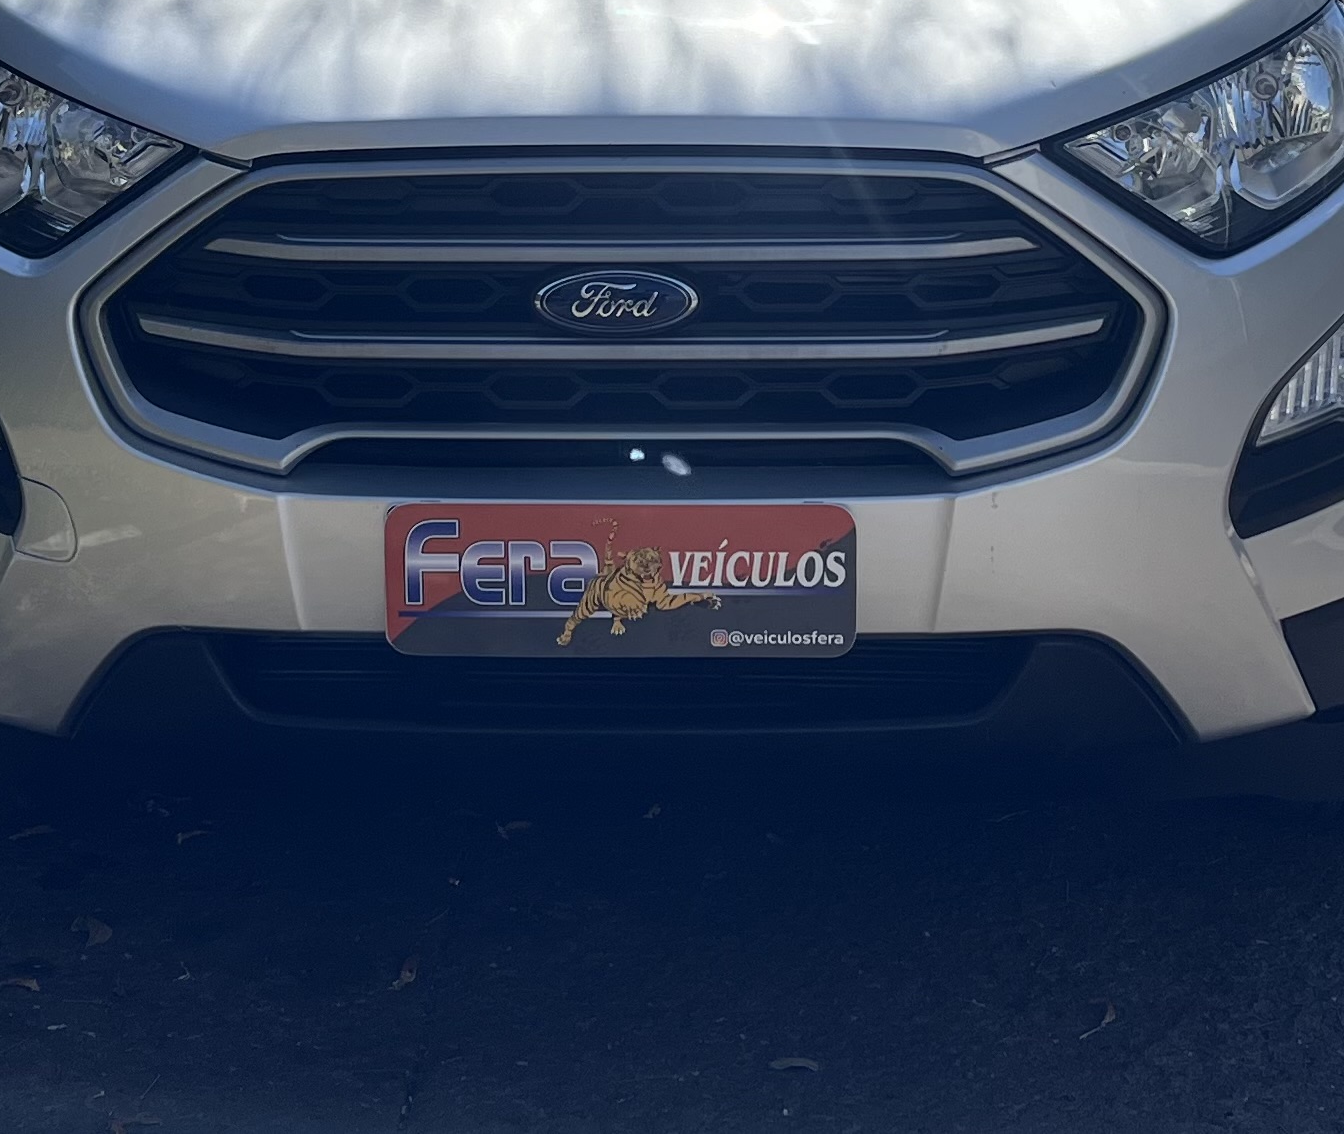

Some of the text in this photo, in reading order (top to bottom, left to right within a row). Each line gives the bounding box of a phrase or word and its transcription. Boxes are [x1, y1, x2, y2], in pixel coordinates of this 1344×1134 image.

[571, 281, 659, 318] Ford
[668, 538, 847, 588] VEÍCULOS
[728, 629, 844, 646] @veiculosfera
